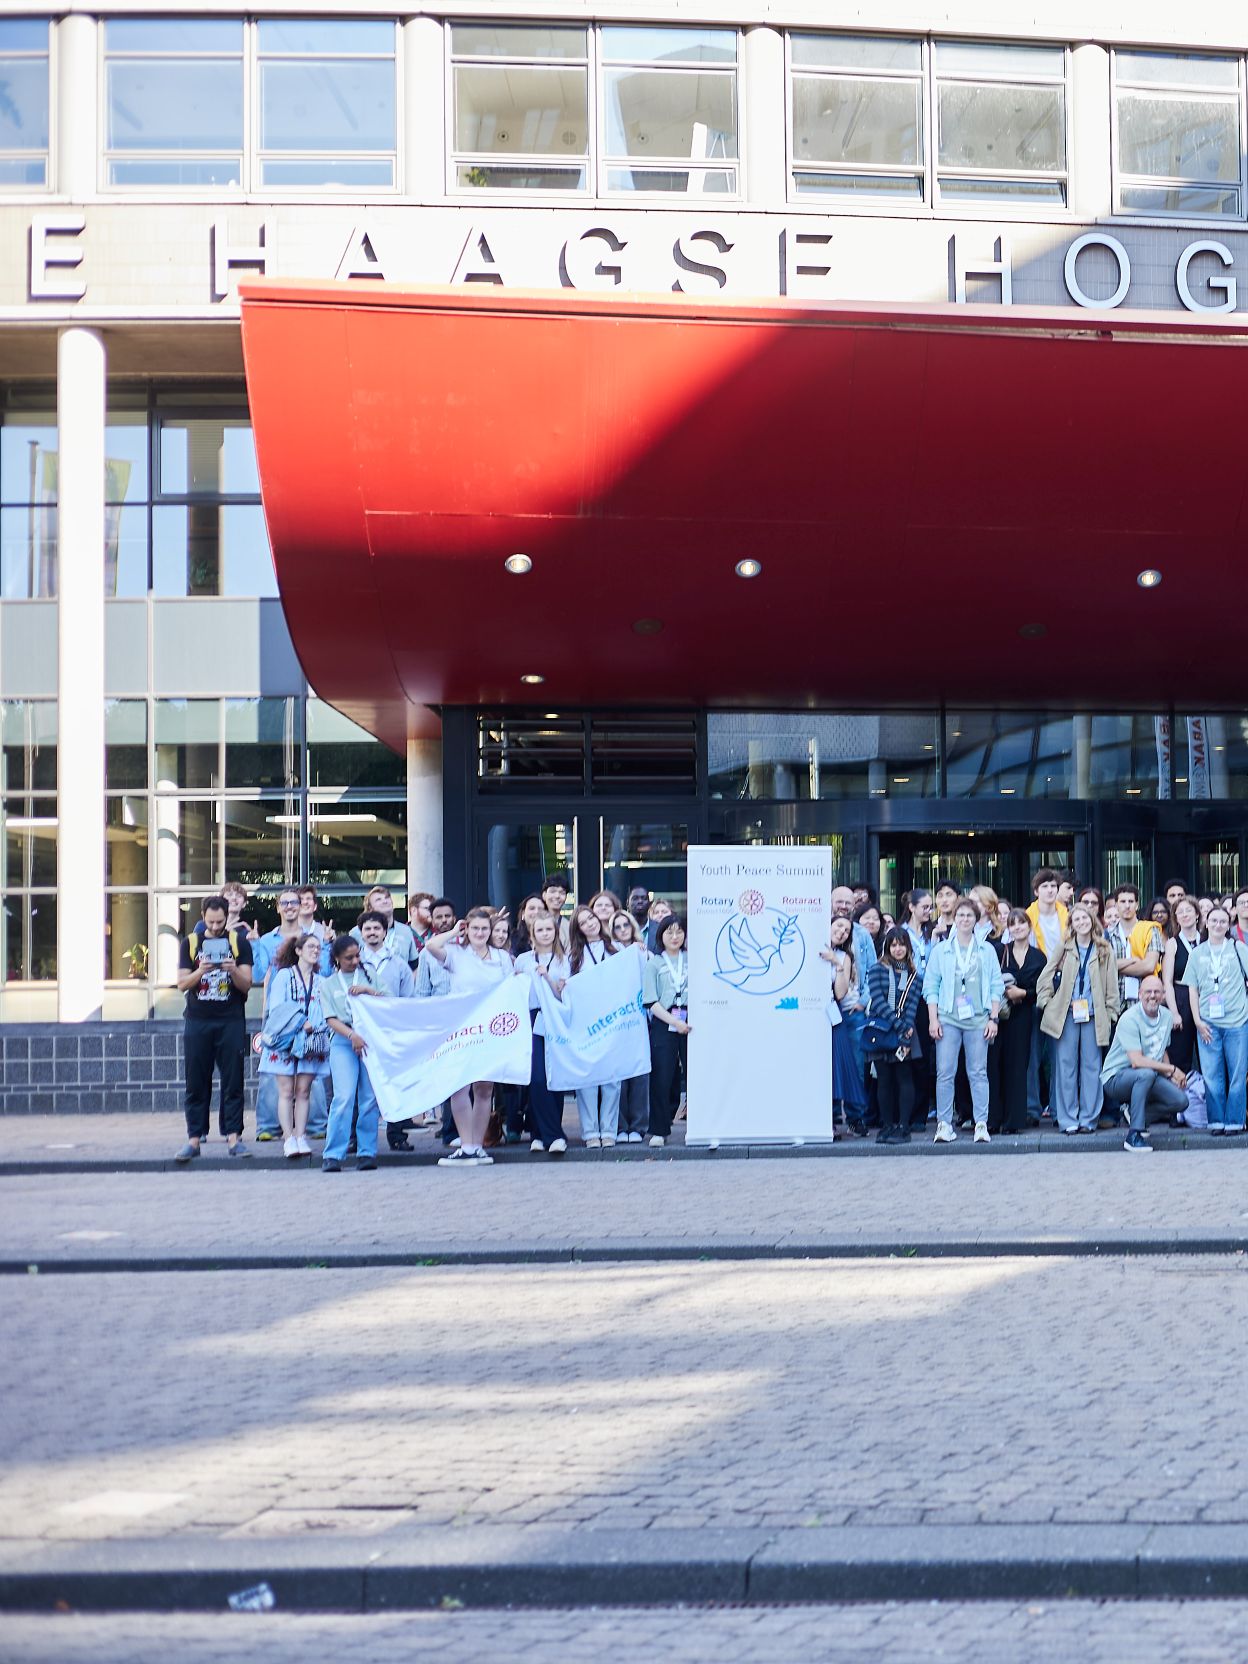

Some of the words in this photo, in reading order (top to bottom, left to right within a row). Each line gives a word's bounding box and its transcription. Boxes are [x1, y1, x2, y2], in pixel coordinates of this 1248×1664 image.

[209, 214, 834, 303] HAAGSE
[699, 863, 731, 876] Youth
[736, 864, 772, 876] Peace
[776, 864, 825, 877] Summit
[701, 896, 734, 907] Rotary
[782, 896, 822, 905] Rotaract
[586, 1002, 637, 1037] Interact
